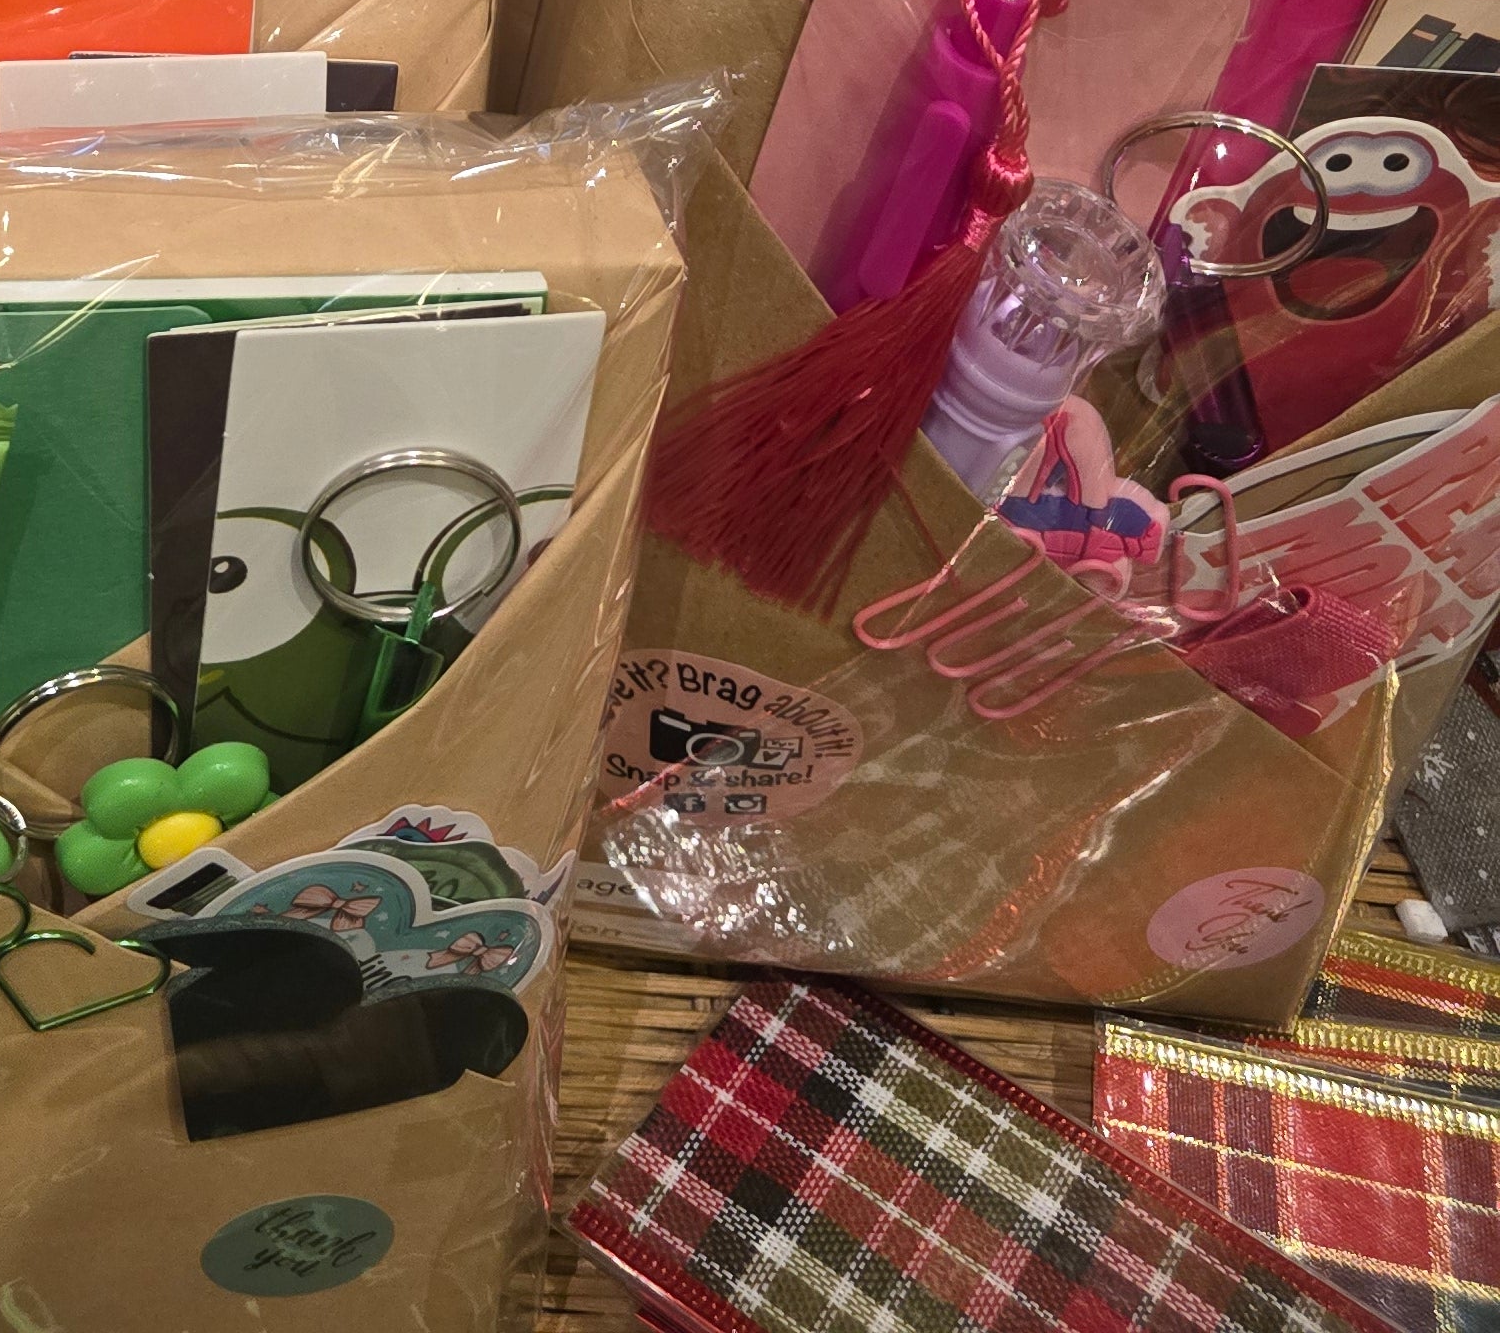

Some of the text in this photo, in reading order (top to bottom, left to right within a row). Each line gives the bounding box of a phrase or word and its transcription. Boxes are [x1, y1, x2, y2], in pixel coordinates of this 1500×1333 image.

[619, 658, 670, 692] it?
[676, 661, 762, 710] Brag
[763, 694, 850, 739] about
[606, 752, 680, 790] Snap
[725, 763, 813, 788] share!
